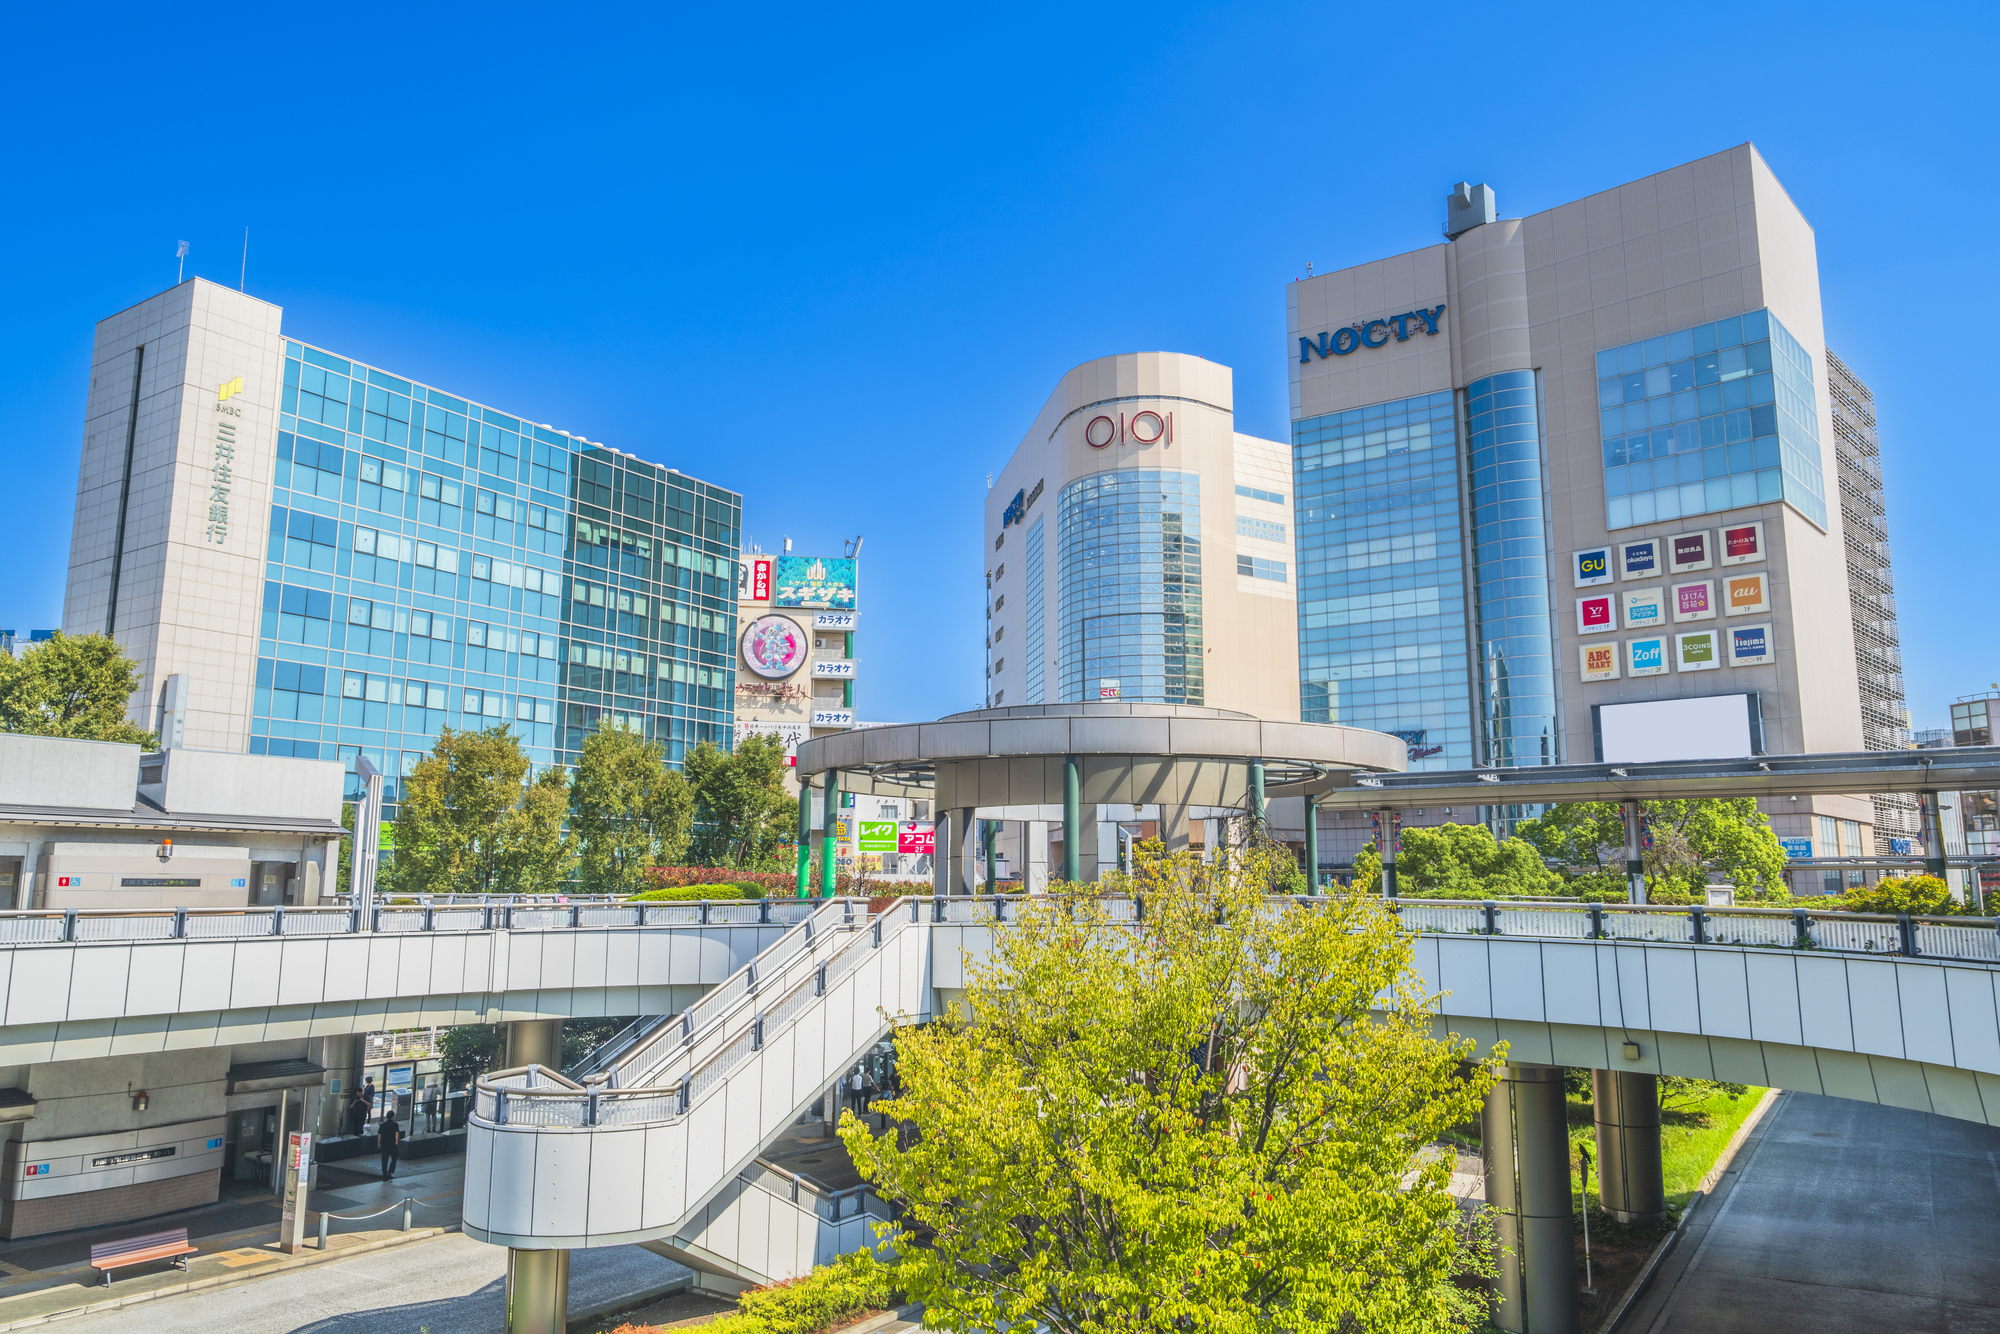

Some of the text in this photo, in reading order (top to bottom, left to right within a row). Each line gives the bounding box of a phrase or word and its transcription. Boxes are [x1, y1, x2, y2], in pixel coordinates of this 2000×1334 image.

[1299, 304, 1446, 363] NOCTY
[216, 403, 242, 418] SMBC
[206, 422, 236, 544] 三井住友銀行
[1626, 555, 1653, 564] okadaya
[1581, 558, 1605, 572] GU
[778, 586, 855, 602] スギザキ
[1681, 592, 1705, 601] ほけん
[1733, 586, 1759, 598] au
[1588, 607, 1603, 616] Y!
[818, 615, 852, 625] カラオケ
[1683, 642, 1712, 651] 3COINS
[1735, 637, 1764, 647] nojima
[1588, 650, 1610, 662] ABC
[1634, 647, 1660, 661] Zoff
[817, 664, 851, 673] カラオケ
[1588, 660, 1611, 670] MART
[816, 713, 850, 722] カラオケ
[861, 824, 893, 836] レイク
[904, 834, 934, 844] アコム
[303, 1137, 309, 1145] 7
